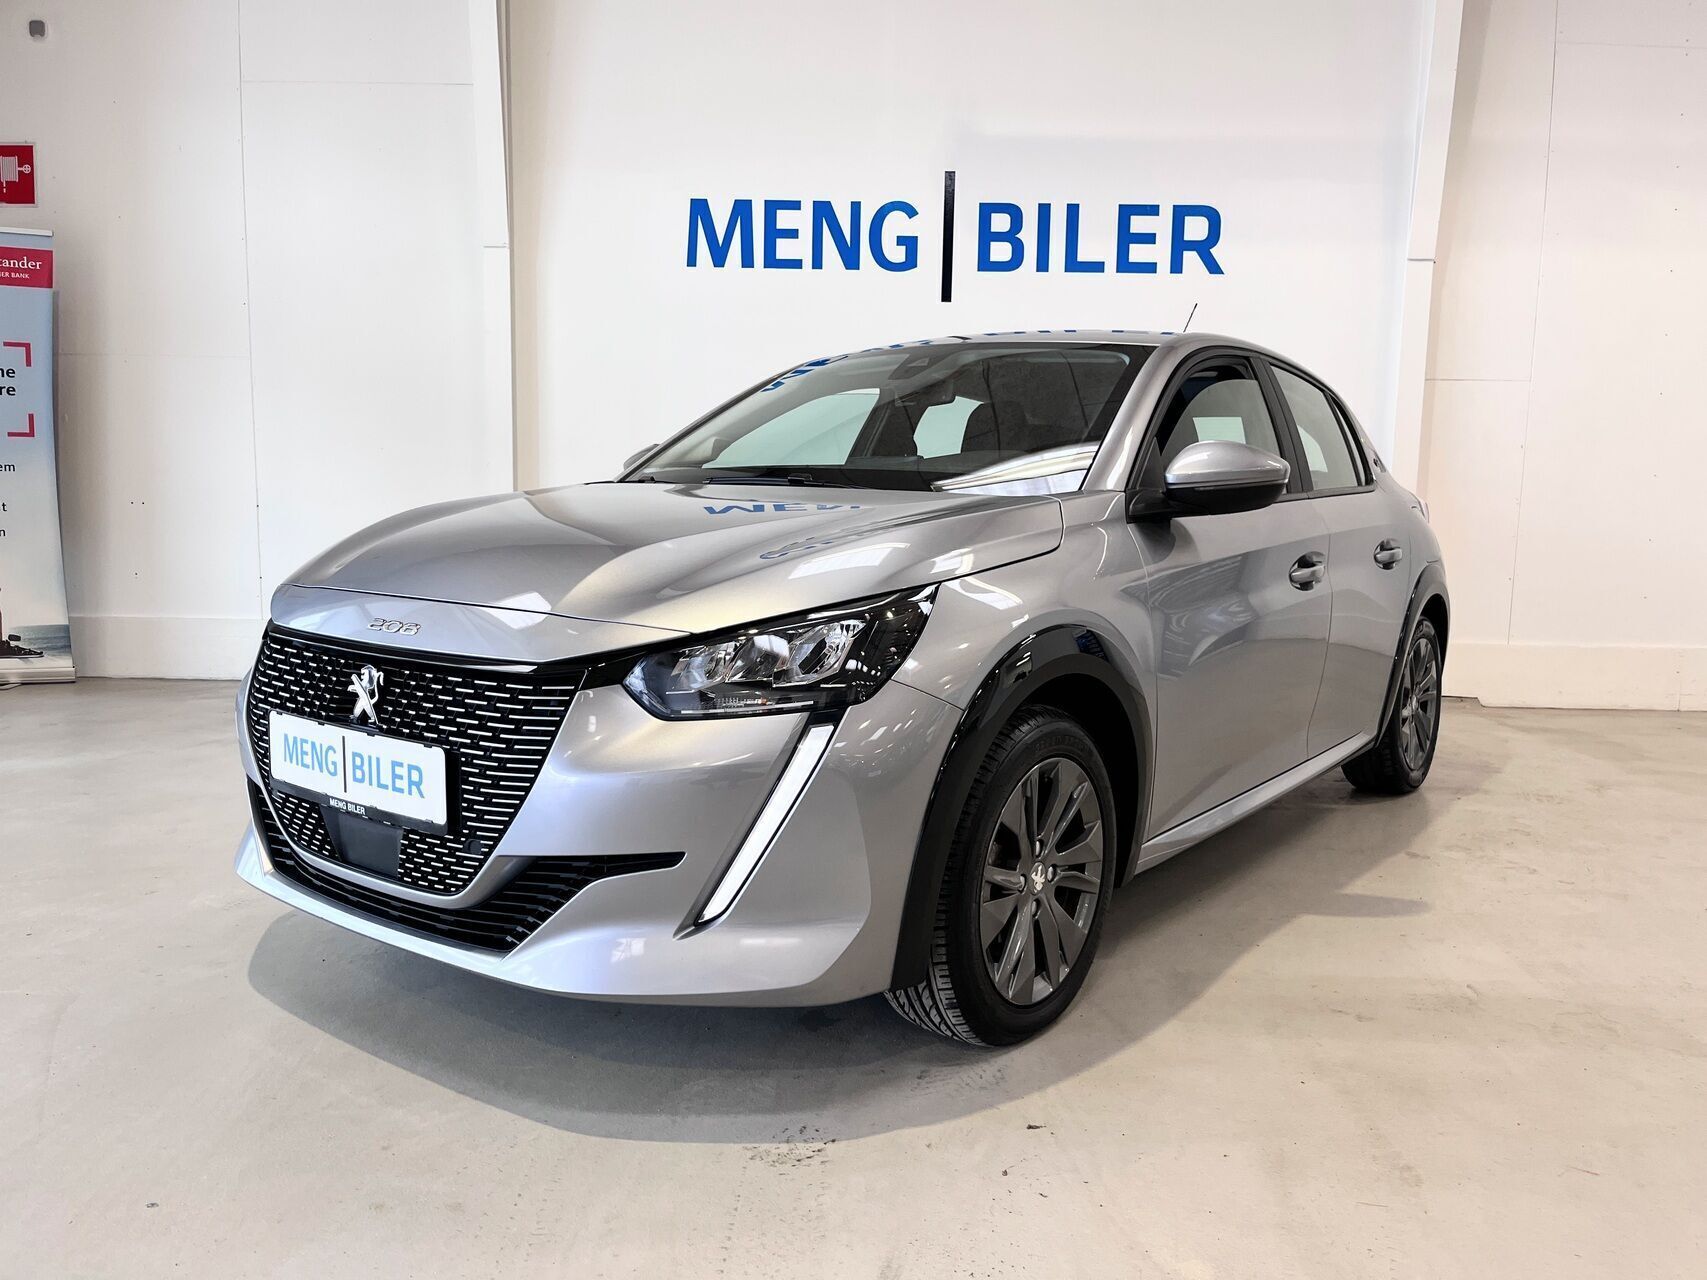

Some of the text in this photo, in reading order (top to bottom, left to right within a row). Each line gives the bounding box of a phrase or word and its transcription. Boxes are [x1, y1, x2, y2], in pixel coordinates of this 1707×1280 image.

[687, 198, 1224, 275] MENG BILER
[368, 617, 421, 636] 208
[283, 733, 425, 799] MENG BILER
[329, 797, 366, 815] MENG BILER
